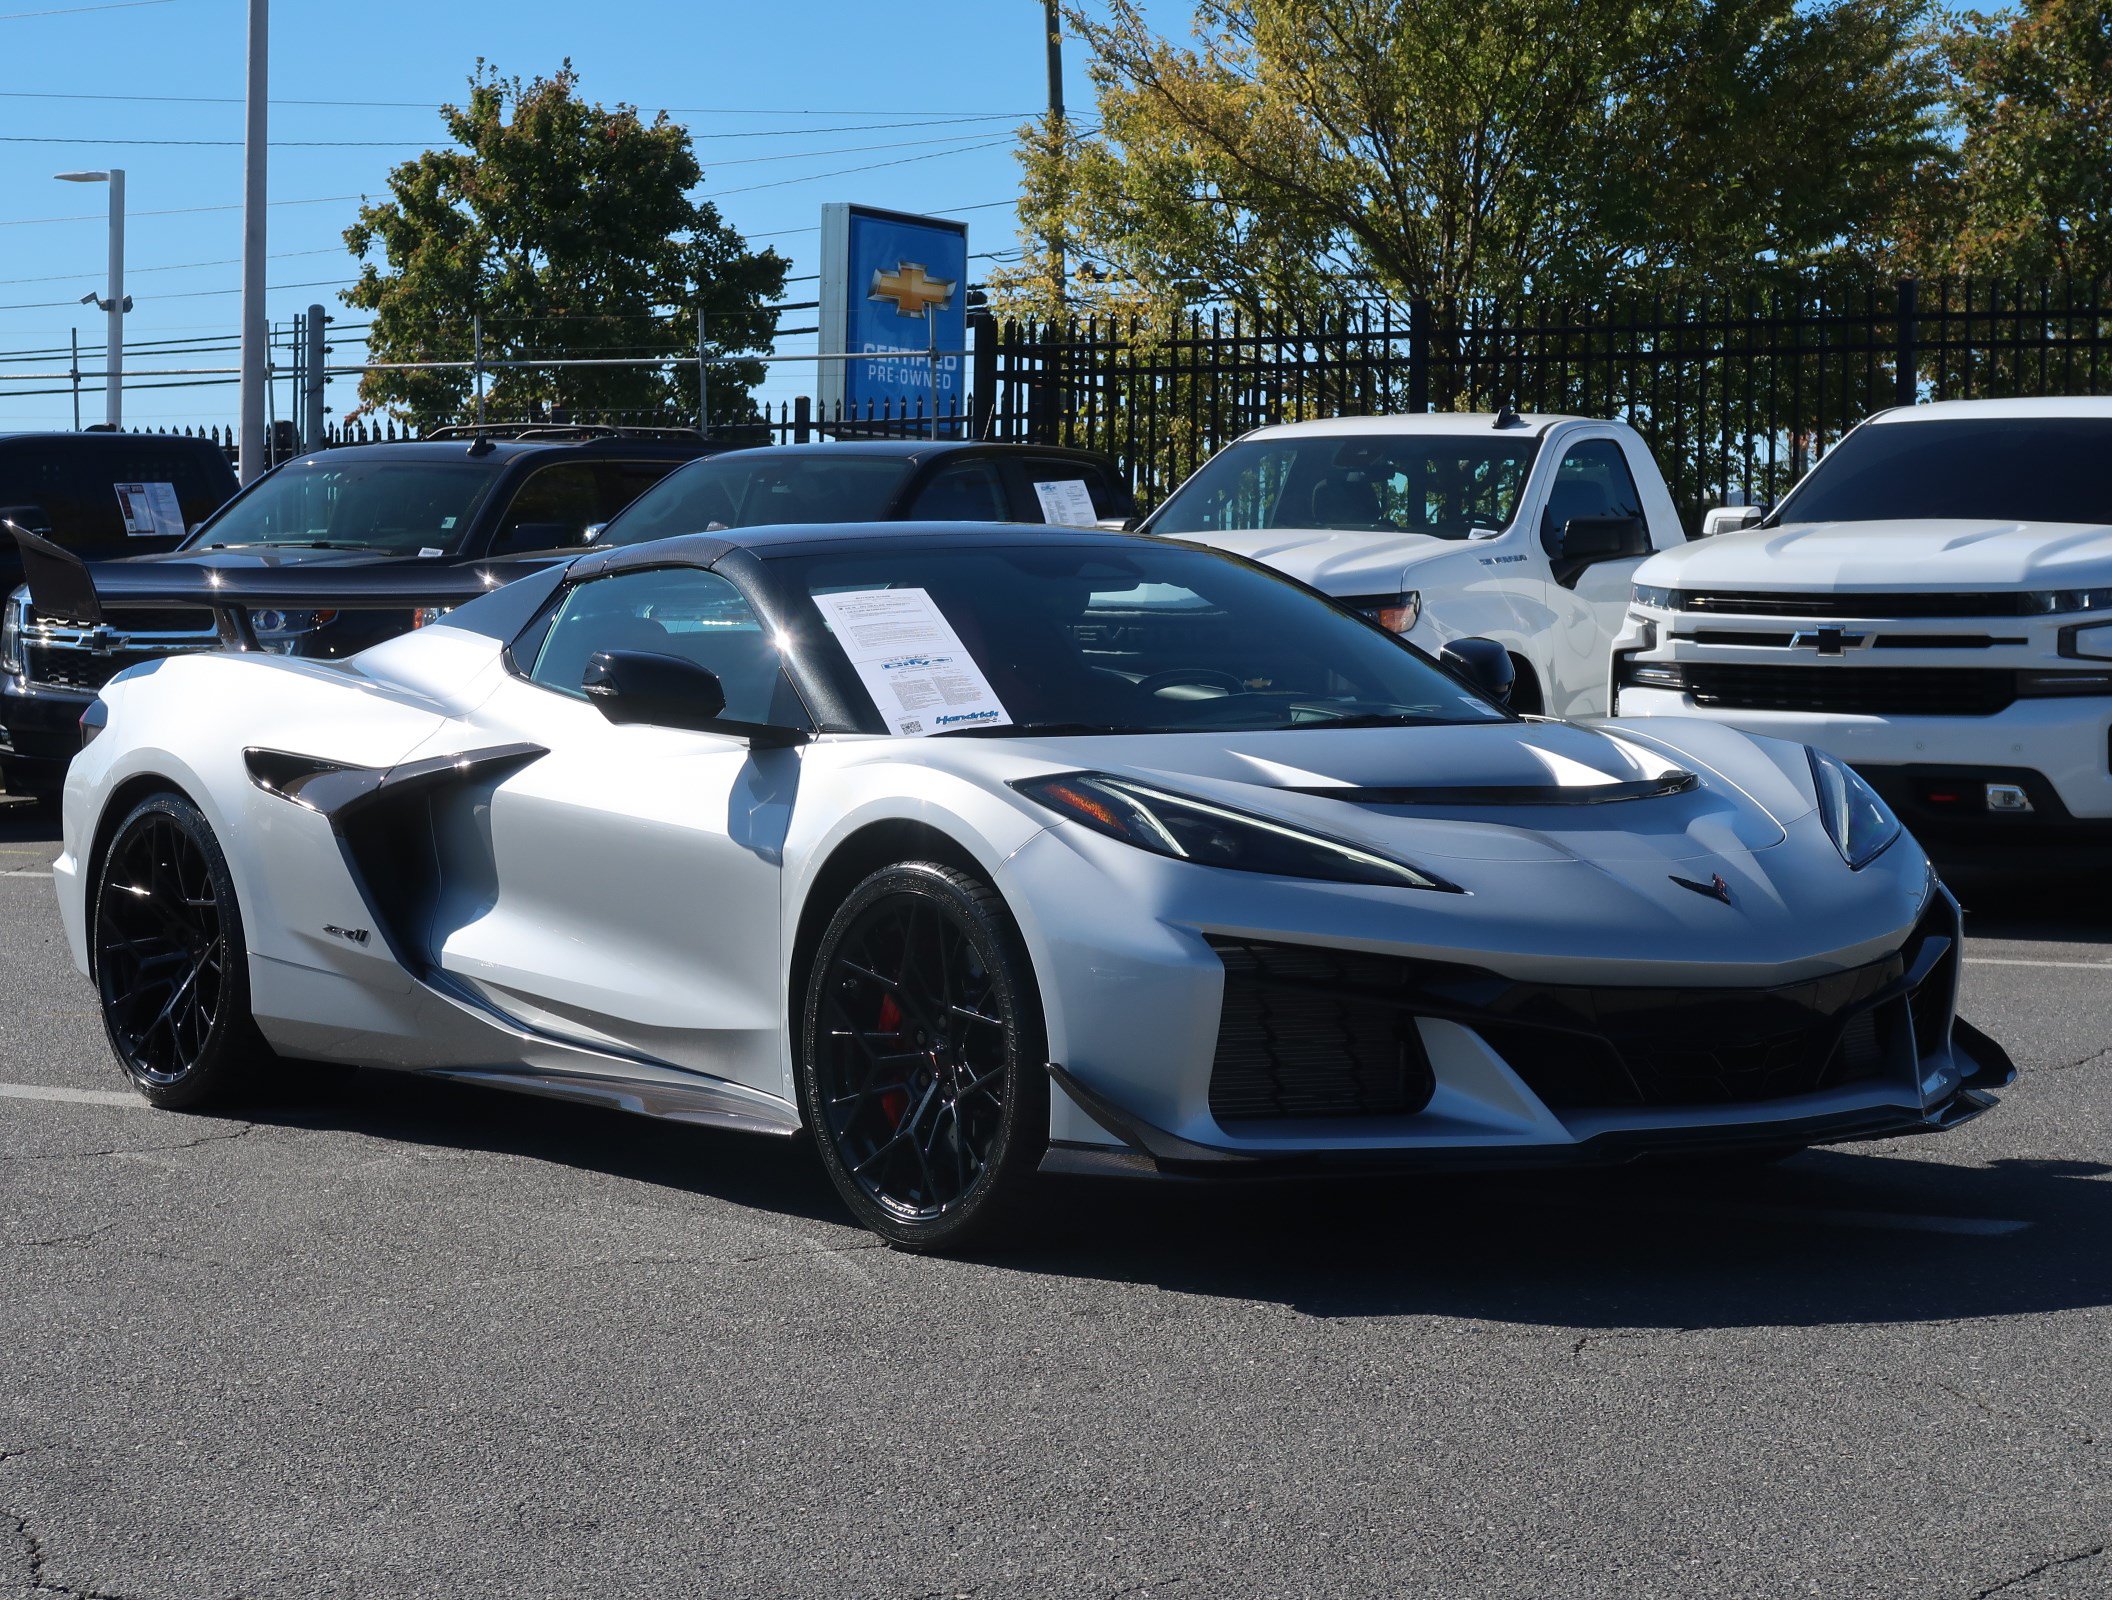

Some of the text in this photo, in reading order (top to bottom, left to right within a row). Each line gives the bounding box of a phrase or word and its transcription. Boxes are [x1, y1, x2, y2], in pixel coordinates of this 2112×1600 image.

[863, 343, 957, 371] CERTIFIED
[868, 364, 951, 390] PRE-OWNED
[935, 710, 999, 725] Hendrick
[881, 1196, 917, 1215] CORVETTE
